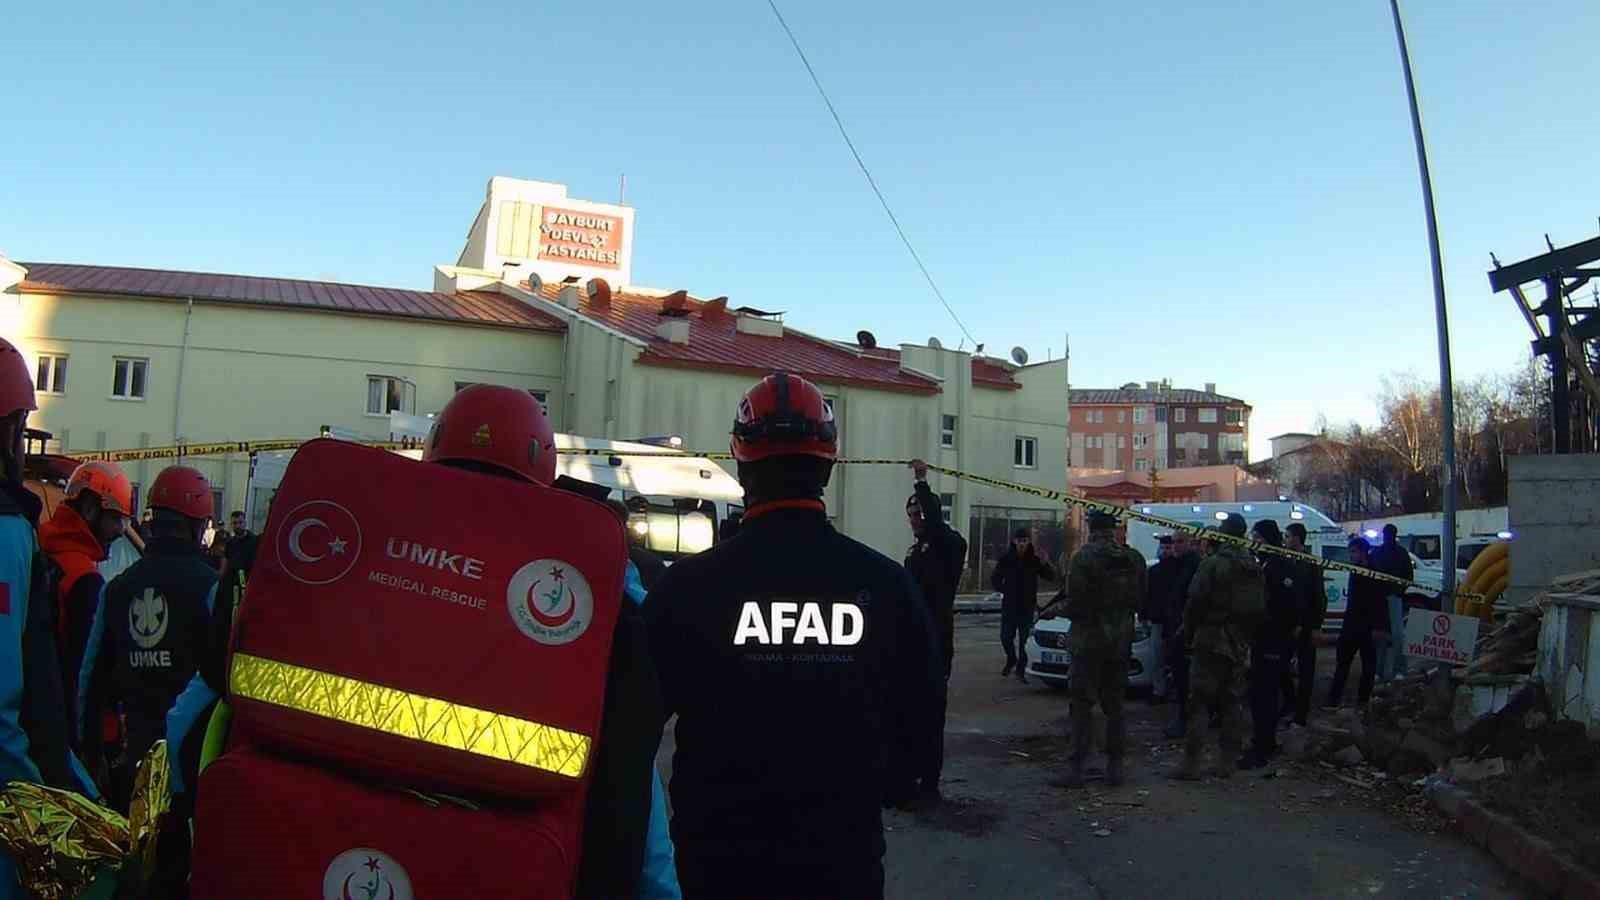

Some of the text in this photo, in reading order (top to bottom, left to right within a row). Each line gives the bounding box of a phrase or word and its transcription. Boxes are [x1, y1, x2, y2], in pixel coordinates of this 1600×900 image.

[386, 537, 486, 581] UMKE
[368, 570, 488, 612] MEDICAL RESCUE
[733, 601, 864, 645] AFAD
[1424, 635, 1456, 649] PARK
[130, 651, 171, 668] UMKE
